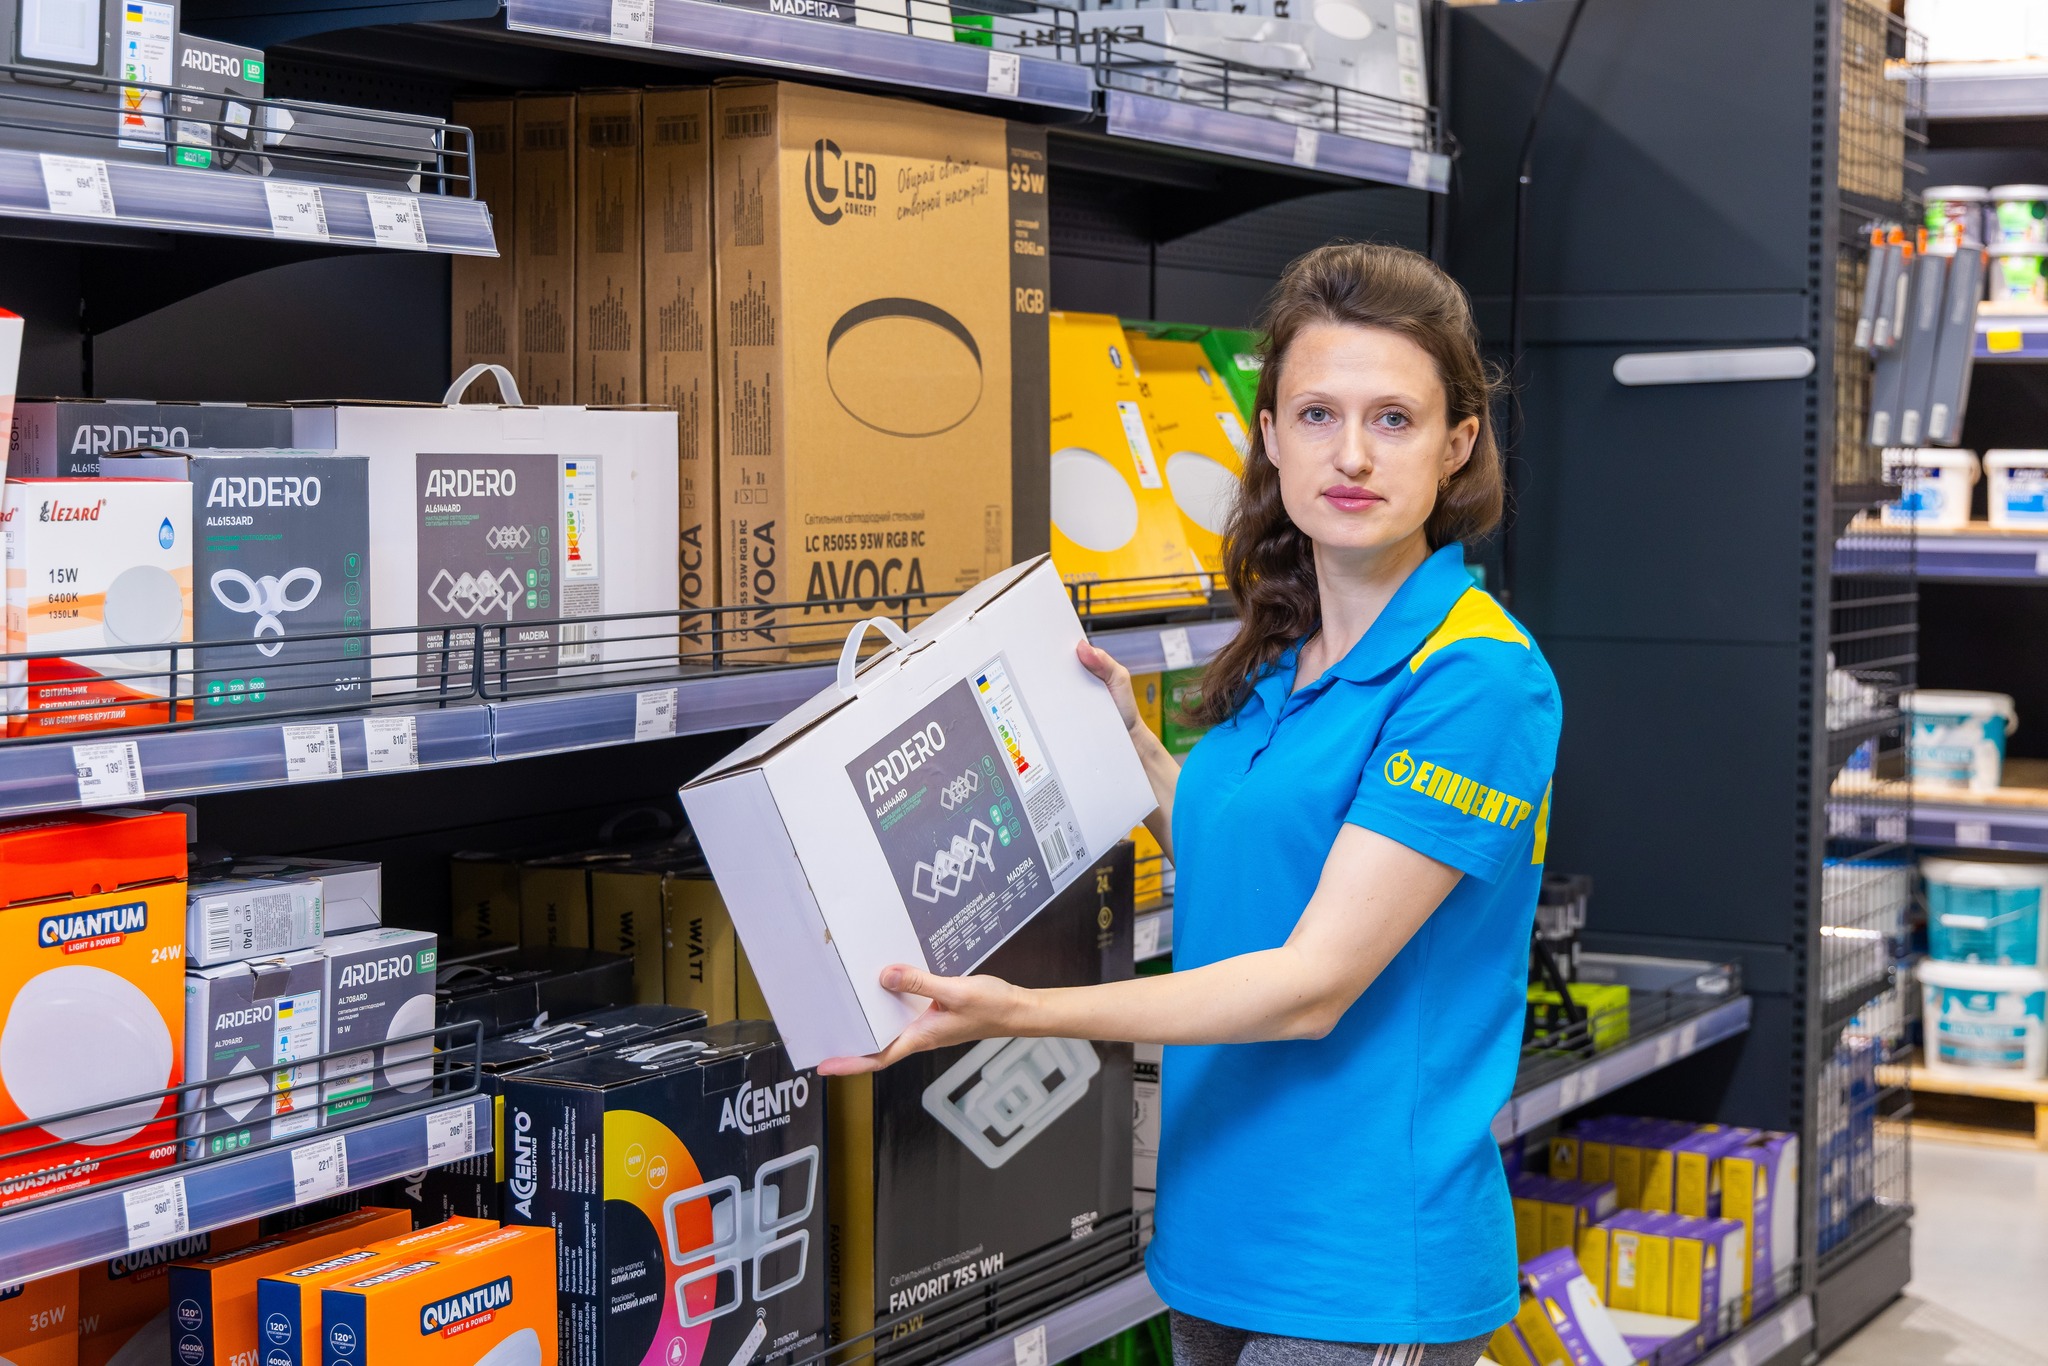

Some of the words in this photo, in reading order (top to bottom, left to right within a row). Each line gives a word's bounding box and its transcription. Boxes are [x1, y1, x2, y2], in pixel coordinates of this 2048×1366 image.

[181, 48, 240, 77] ARDERO
[247, 64, 260, 75] LED
[844, 160, 876, 201] LED
[897, 164, 936, 194] Обирай
[844, 202, 876, 217] CONCEPT
[1015, 288, 1044, 314] RGB
[71, 424, 190, 455] ARDERO
[206, 476, 322, 507] ARDERO
[424, 468, 517, 498] ARDERO
[424, 503, 461, 514] AL6144ARD
[206, 516, 254, 526] AL6153ARD
[740, 519, 748, 535] RC
[805, 513, 844, 526] Світильник
[740, 537, 748, 561] RGB
[805, 535, 820, 552] LC
[823, 533, 857, 552] R5055
[860, 532, 884, 550] 93W
[886, 531, 908, 549] RGB
[911, 530, 926, 547] RC
[48, 568, 79, 583] 15W
[680, 523, 703, 646] AVOCA
[740, 564, 748, 588] 93W
[753, 520, 776, 643] AVOCA
[803, 557, 927, 615] AVOCA
[48, 592, 79, 604] 6400K
[48, 609, 79, 619] 1350LM
[518, 630, 550, 642] MADEIRA
[40, 685, 88, 698] СВІТИЛЬНИК
[94, 709, 126, 720] КРУГЛИЙ
[306, 742, 321, 753] 1367
[392, 735, 404, 745] 810
[106, 762, 118, 774] 139
[865, 721, 946, 804] ARDERO
[875, 788, 908, 819] AL6144ARD
[1410, 760, 1532, 830] ЕПІЦЕНТР
[1006, 856, 1034, 884] MADEIRA
[244, 904, 252, 922] LED
[42, 905, 145, 944] QUANTUM
[68, 941, 88, 952] LIGHT
[95, 936, 121, 948] POWER
[243, 928, 253, 949] IP40
[151, 944, 182, 964] 24W
[420, 952, 435, 965] LED
[688, 917, 704, 984] WATT
[339, 954, 413, 989] ARDERO
[338, 993, 368, 1005] AL708ARD
[215, 1005, 273, 1031] ARDERO
[337, 1026, 344, 1034] 18
[344, 1025, 351, 1033] W
[214, 1036, 243, 1048] AL709ARD
[335, 1079, 346, 1087] 5000
[718, 1076, 809, 1135] ACCENTO
[450, 1126, 460, 1137] 206
[754, 1114, 791, 1134] LIGHTING
[319, 1159, 330, 1172] 221
[509, 1111, 538, 1220] ACCENTO
[628, 1155, 642, 1166] 90W
[650, 1165, 665, 1177] IP20
[154, 1202, 168, 1215] 360
[291, 1251, 376, 1277] QUANTUM
[354, 1260, 435, 1288] QUANTUM
[611, 1268, 647, 1285] БІЛИЙ/ХРОМ
[889, 1263, 932, 1287] Світильник
[889, 1272, 951, 1314] FAVORIT
[953, 1263, 977, 1288] 75S
[979, 1251, 1004, 1278] WH
[423, 1280, 511, 1331] QUANTUM
[611, 1297, 639, 1315] МАТОВИЙ
[638, 1293, 658, 1306] АКРИЛ
[29, 1305, 66, 1332] 36W
[447, 1325, 464, 1336] LIGHT
[470, 1314, 492, 1328] POWER
[181, 1343, 203, 1352] 4000K
[777, 1329, 799, 1346] ПУЛЬТОМ
